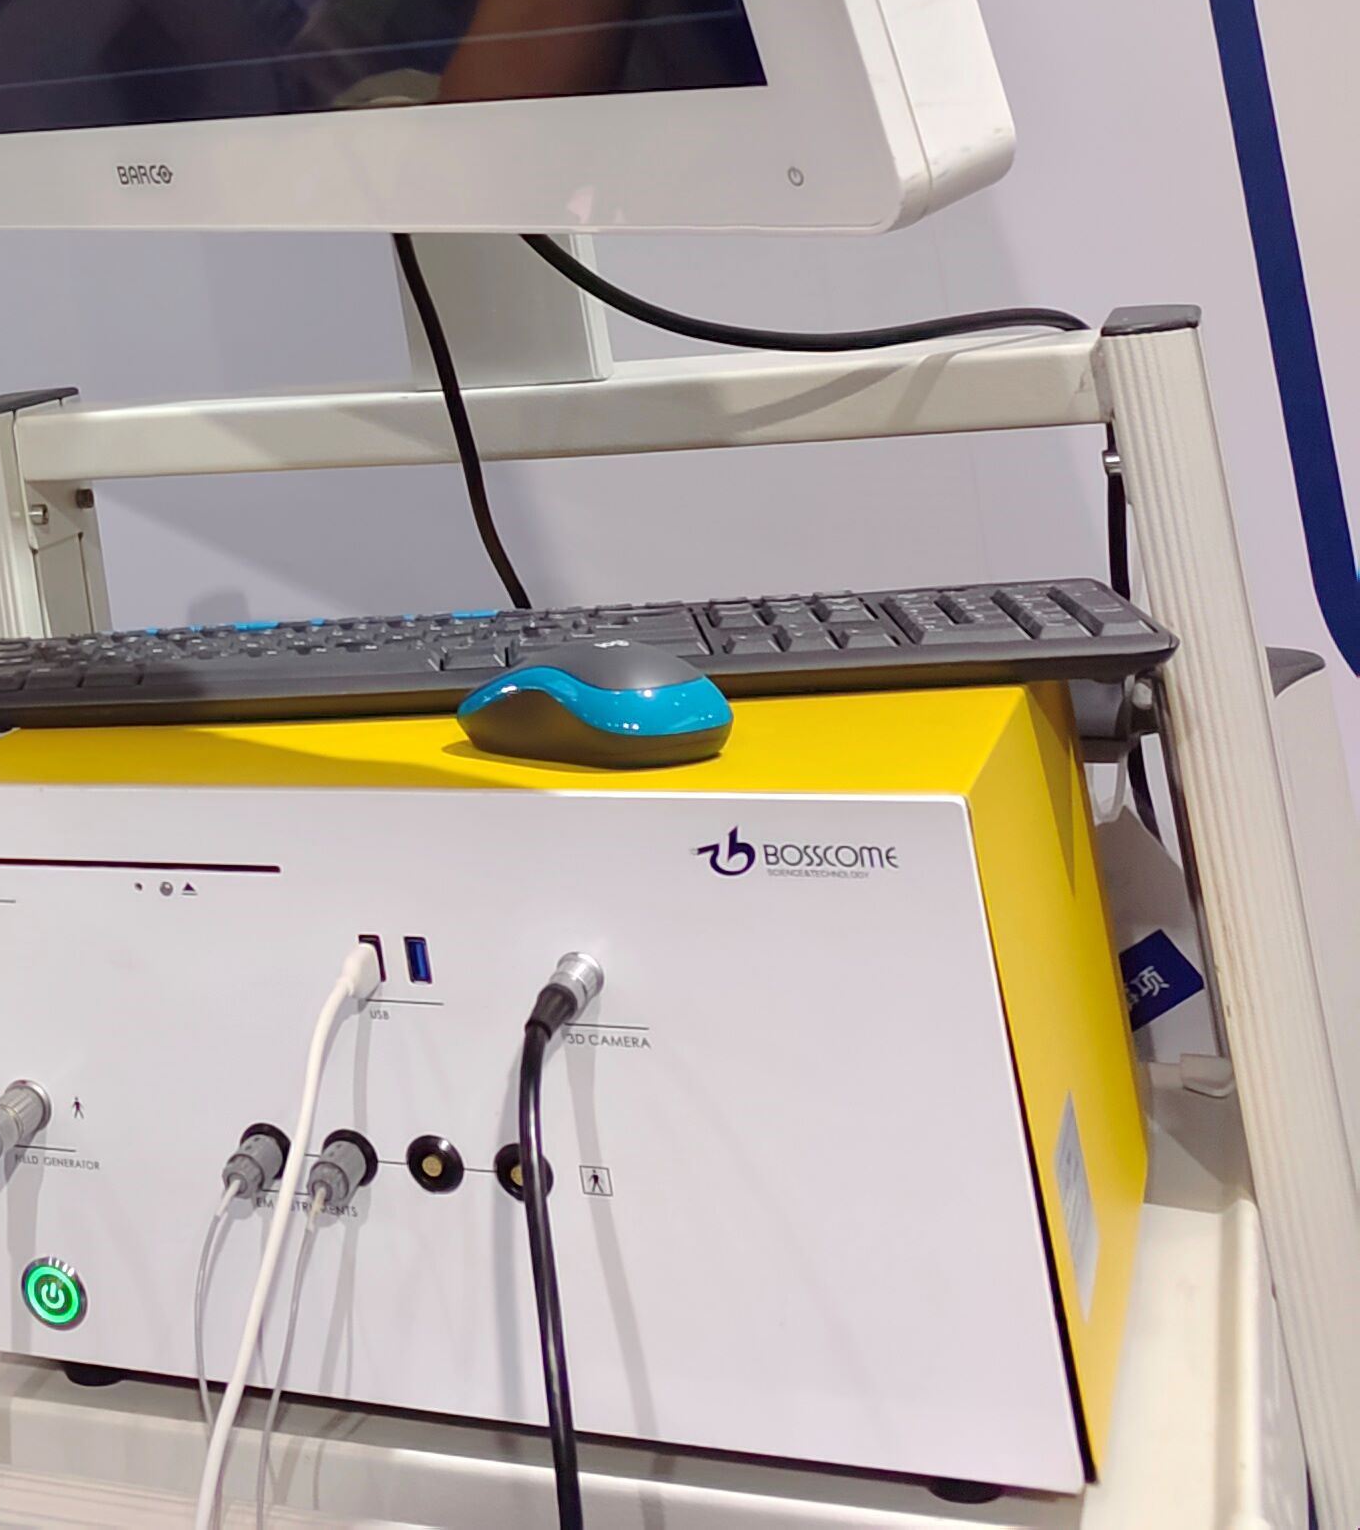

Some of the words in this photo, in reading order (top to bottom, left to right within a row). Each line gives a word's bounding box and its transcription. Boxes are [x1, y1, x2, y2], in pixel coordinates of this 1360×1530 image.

[117, 165, 173, 184] BARCO
[763, 844, 899, 868] BOSSCOME
[370, 1009, 390, 1020] USB
[566, 1033, 585, 1045] 3D
[588, 1034, 651, 1049] CAMERA
[43, 1157, 100, 1170] GENERATOR
